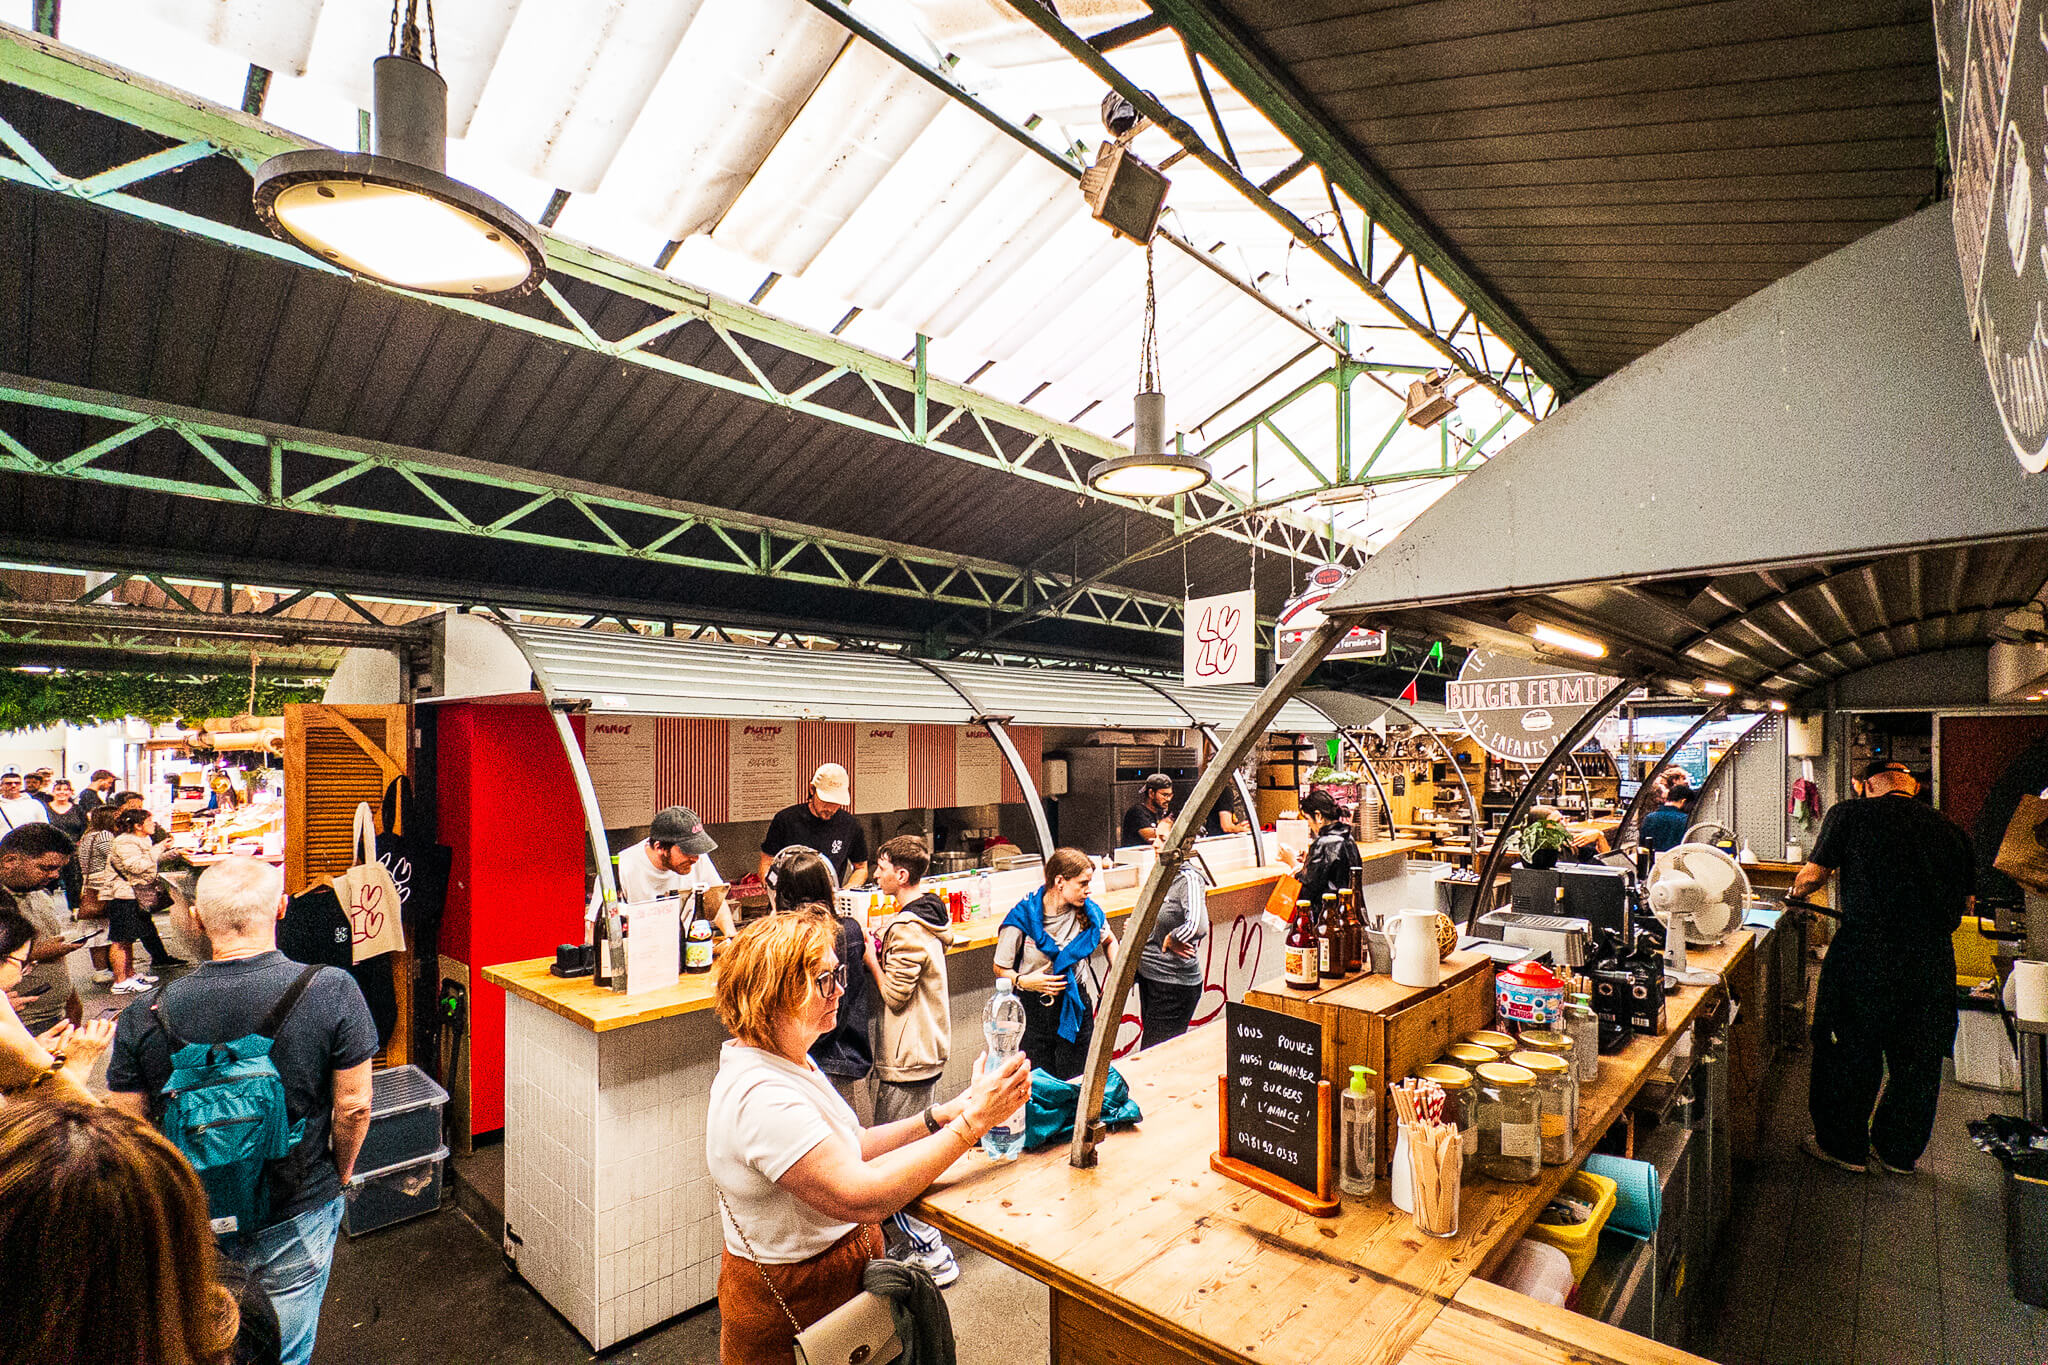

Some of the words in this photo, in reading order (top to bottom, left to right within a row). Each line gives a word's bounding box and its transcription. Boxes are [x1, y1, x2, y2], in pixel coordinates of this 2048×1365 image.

[1468, 654, 1487, 673] LE
[1450, 682, 1521, 710] BURGER
[1467, 711, 1489, 739] DES
[1490, 731, 1548, 757] ENFANTS
[1237, 1023, 1263, 1039] VOUS
[1278, 1035, 1314, 1055] POUVEZ
[1268, 1060, 1316, 1084] COMMANDER
[1239, 1076, 1253, 1087] VOS
[1263, 1081, 1303, 1104] BURGERS
[1240, 1092, 1248, 1108] À
